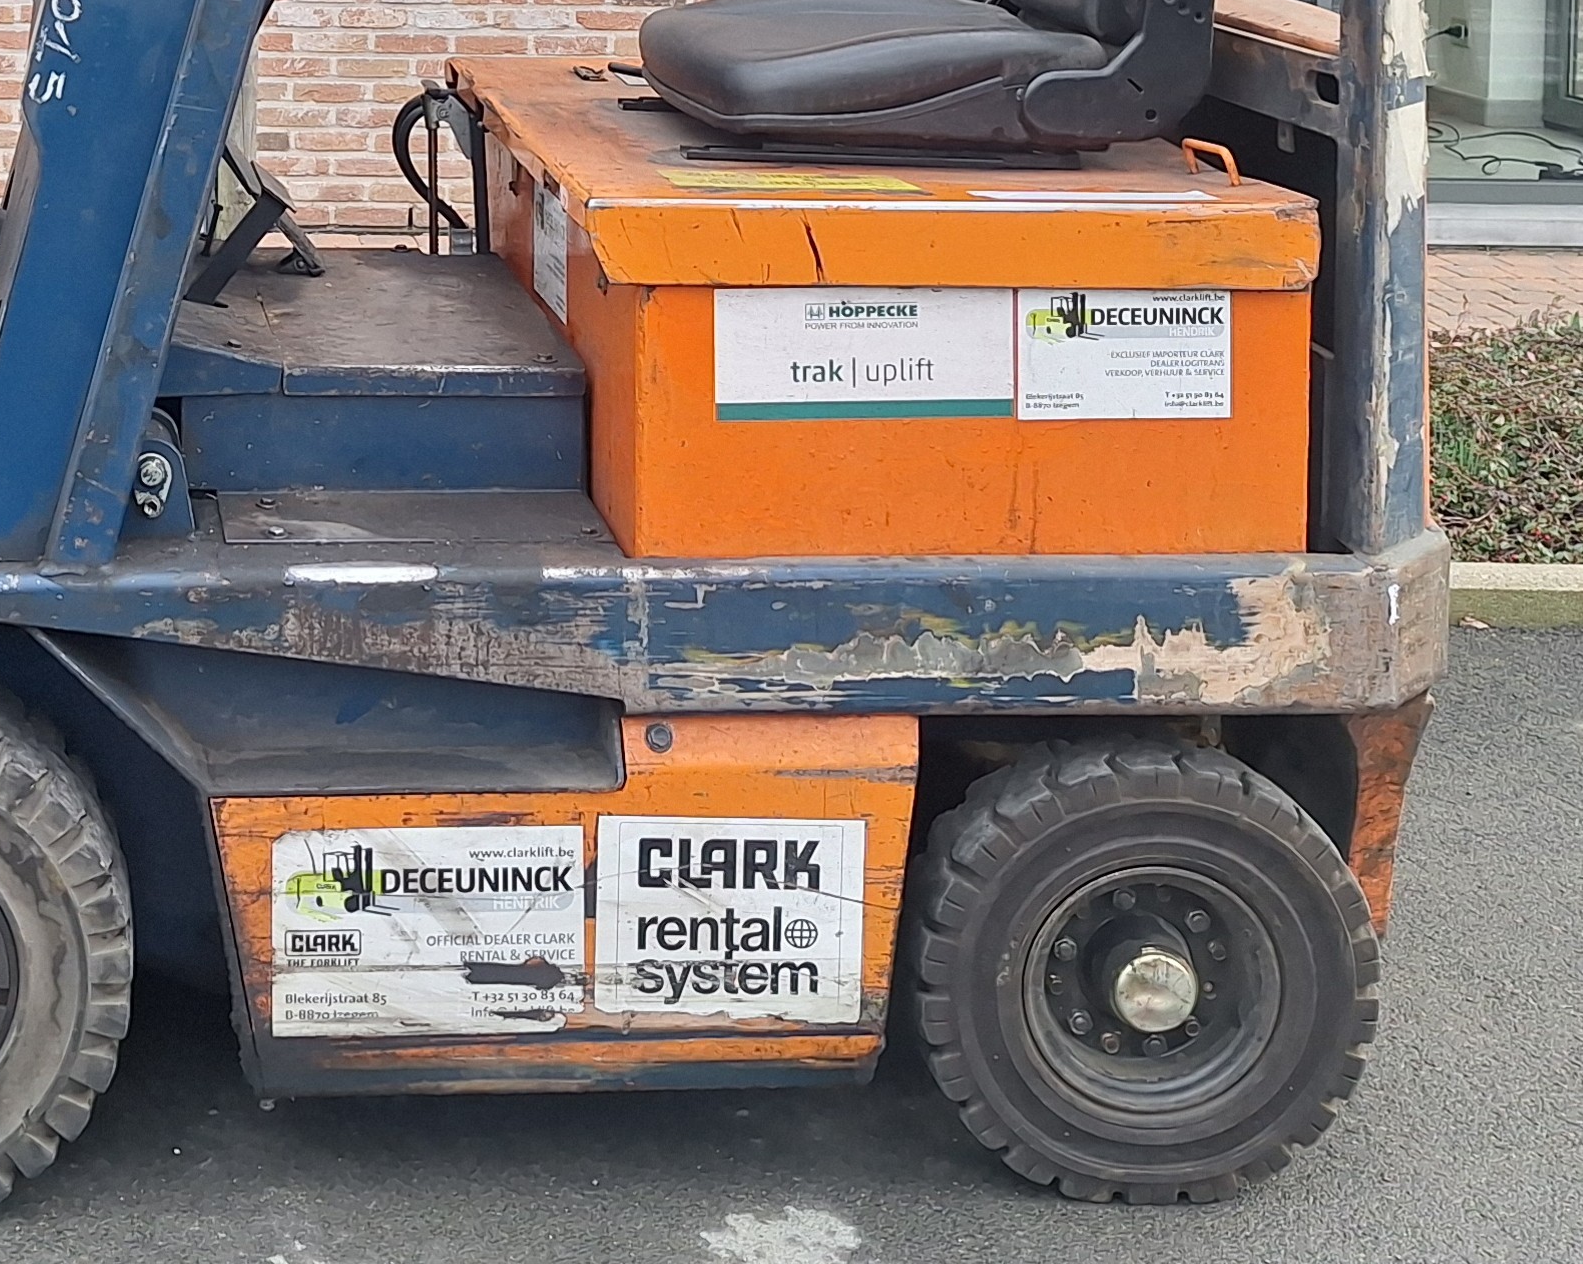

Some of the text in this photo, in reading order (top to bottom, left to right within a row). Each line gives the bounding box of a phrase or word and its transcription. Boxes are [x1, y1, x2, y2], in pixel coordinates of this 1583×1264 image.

[1152, 293, 1225, 302] www.clarklift.be
[828, 302, 918, 318] HÖPPECKE
[1091, 306, 1224, 326] DECEUNINCK
[805, 321, 918, 330] POWER FROM INNOVATION
[1169, 327, 1215, 336] HENDRIK
[1152, 350, 1199, 358] IMPORTEUR
[1200, 350, 1225, 358] CLARK
[1150, 359, 1179, 367] DEALER
[790, 357, 934, 386] trak uplift
[1194, 368, 1225, 376] SERVICE
[469, 846, 575, 861] www.clarklift.be
[639, 837, 821, 890] CLARK
[380, 865, 574, 894] DECEUNINCK
[492, 895, 560, 910] HENDRIK
[637, 906, 783, 952] rental
[291, 934, 358, 953] CLARK
[426, 933, 575, 947] OFFICIAL DEALER CLARK
[460, 948, 576, 962] RENTAL & SERVICE
[287, 958, 359, 967] THE FORKLIFT
[636, 960, 819, 1005] system
[285, 993, 387, 1006] Blekerijstraat 85
[482, 992, 504, 1003] +32
[507, 992, 519, 1002] 51
[521, 992, 537, 1003] 30
[541, 990, 555, 1002] 83
[559, 990, 575, 1001] 64
[285, 1010, 330, 1020] B-8870
